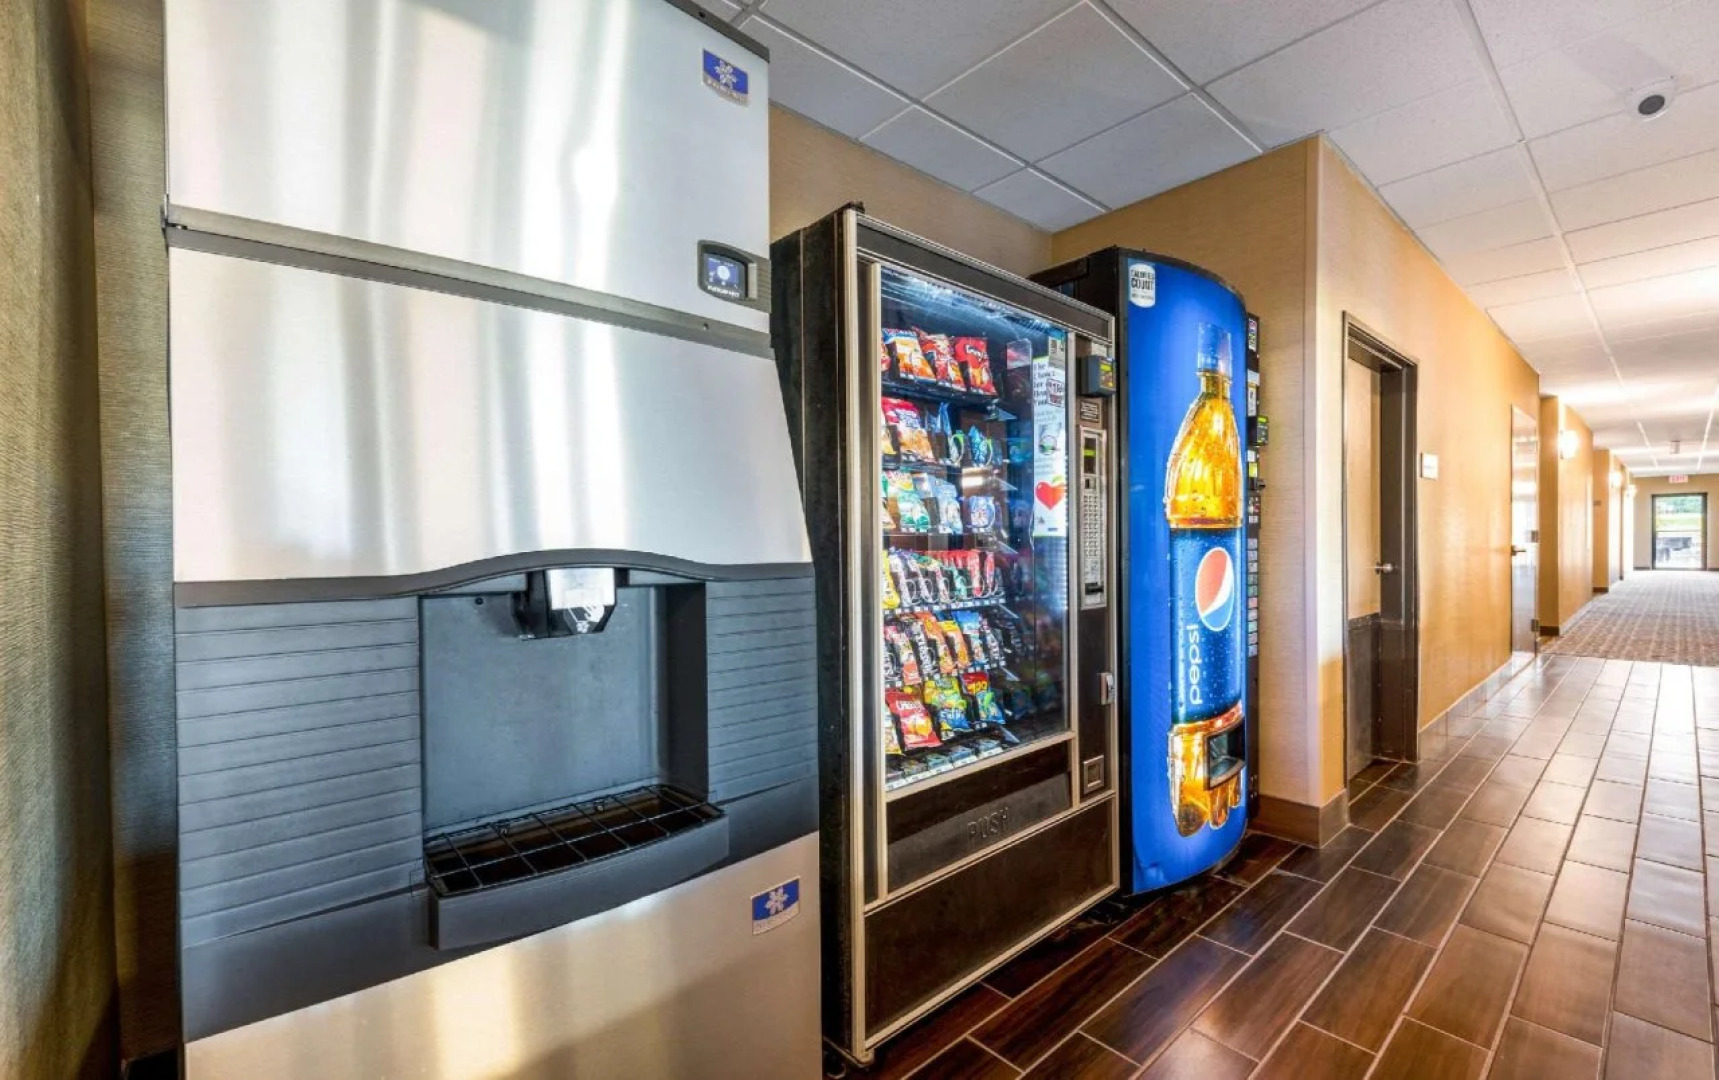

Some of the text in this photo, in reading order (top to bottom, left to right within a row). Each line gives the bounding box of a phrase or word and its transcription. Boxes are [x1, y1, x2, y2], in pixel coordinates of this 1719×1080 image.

[1131, 278, 1153, 290] COUNT
[1186, 625, 1203, 705] pepsi
[967, 805, 1010, 841] PUSH
